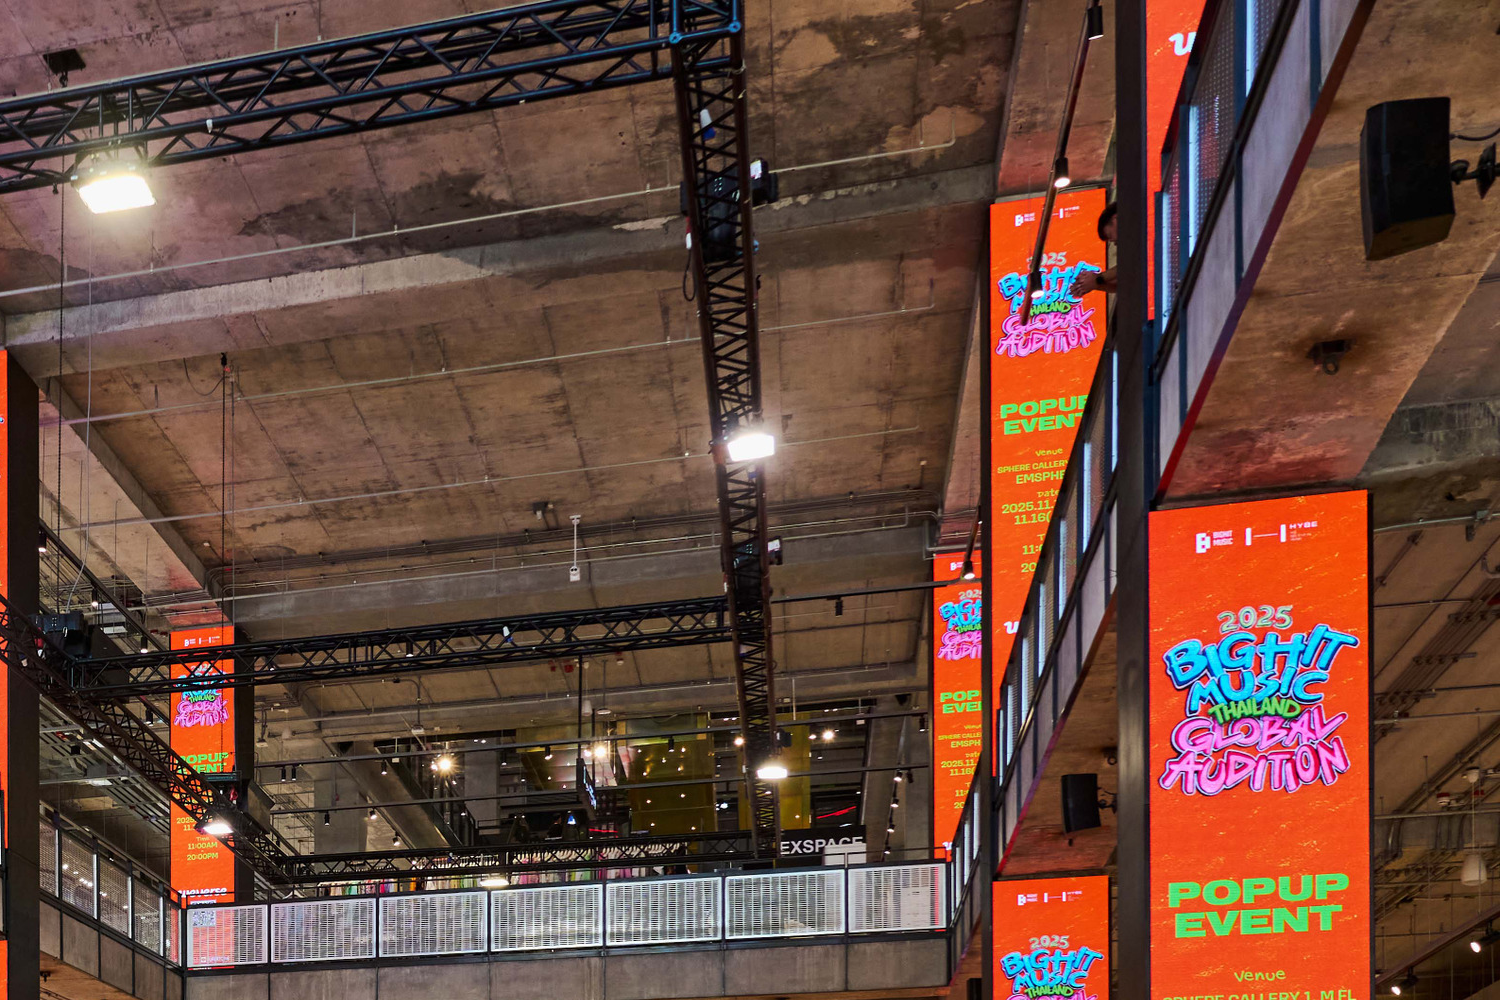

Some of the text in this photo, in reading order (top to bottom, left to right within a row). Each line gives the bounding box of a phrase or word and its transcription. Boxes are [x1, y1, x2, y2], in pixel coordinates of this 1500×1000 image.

[1029, 301, 1071, 316] HAILAND
[996, 321, 1097, 358] AUDITION
[1035, 446, 1063, 457] Venue
[1015, 472, 1065, 484] EMSPHE
[1289, 520, 1318, 530] HYBE
[1218, 605, 1294, 633] 2025
[940, 690, 980, 702] POP
[1186, 667, 1330, 717] MUSIC
[943, 701, 982, 714] EVE
[1208, 696, 1301, 725] THAILAND
[1171, 705, 1348, 755] GLOBAL
[1159, 736, 1351, 796] AUDITION
[1168, 873, 1349, 908] POPUP
[1175, 905, 1343, 938] EVENT
[1029, 935, 1069, 950] 2025
[1013, 969, 1088, 993] MUSIC
[1234, 969, 1286, 982] Venue
[1024, 985, 1074, 998] THAILAND
[1338, 990, 1357, 1000] FL
